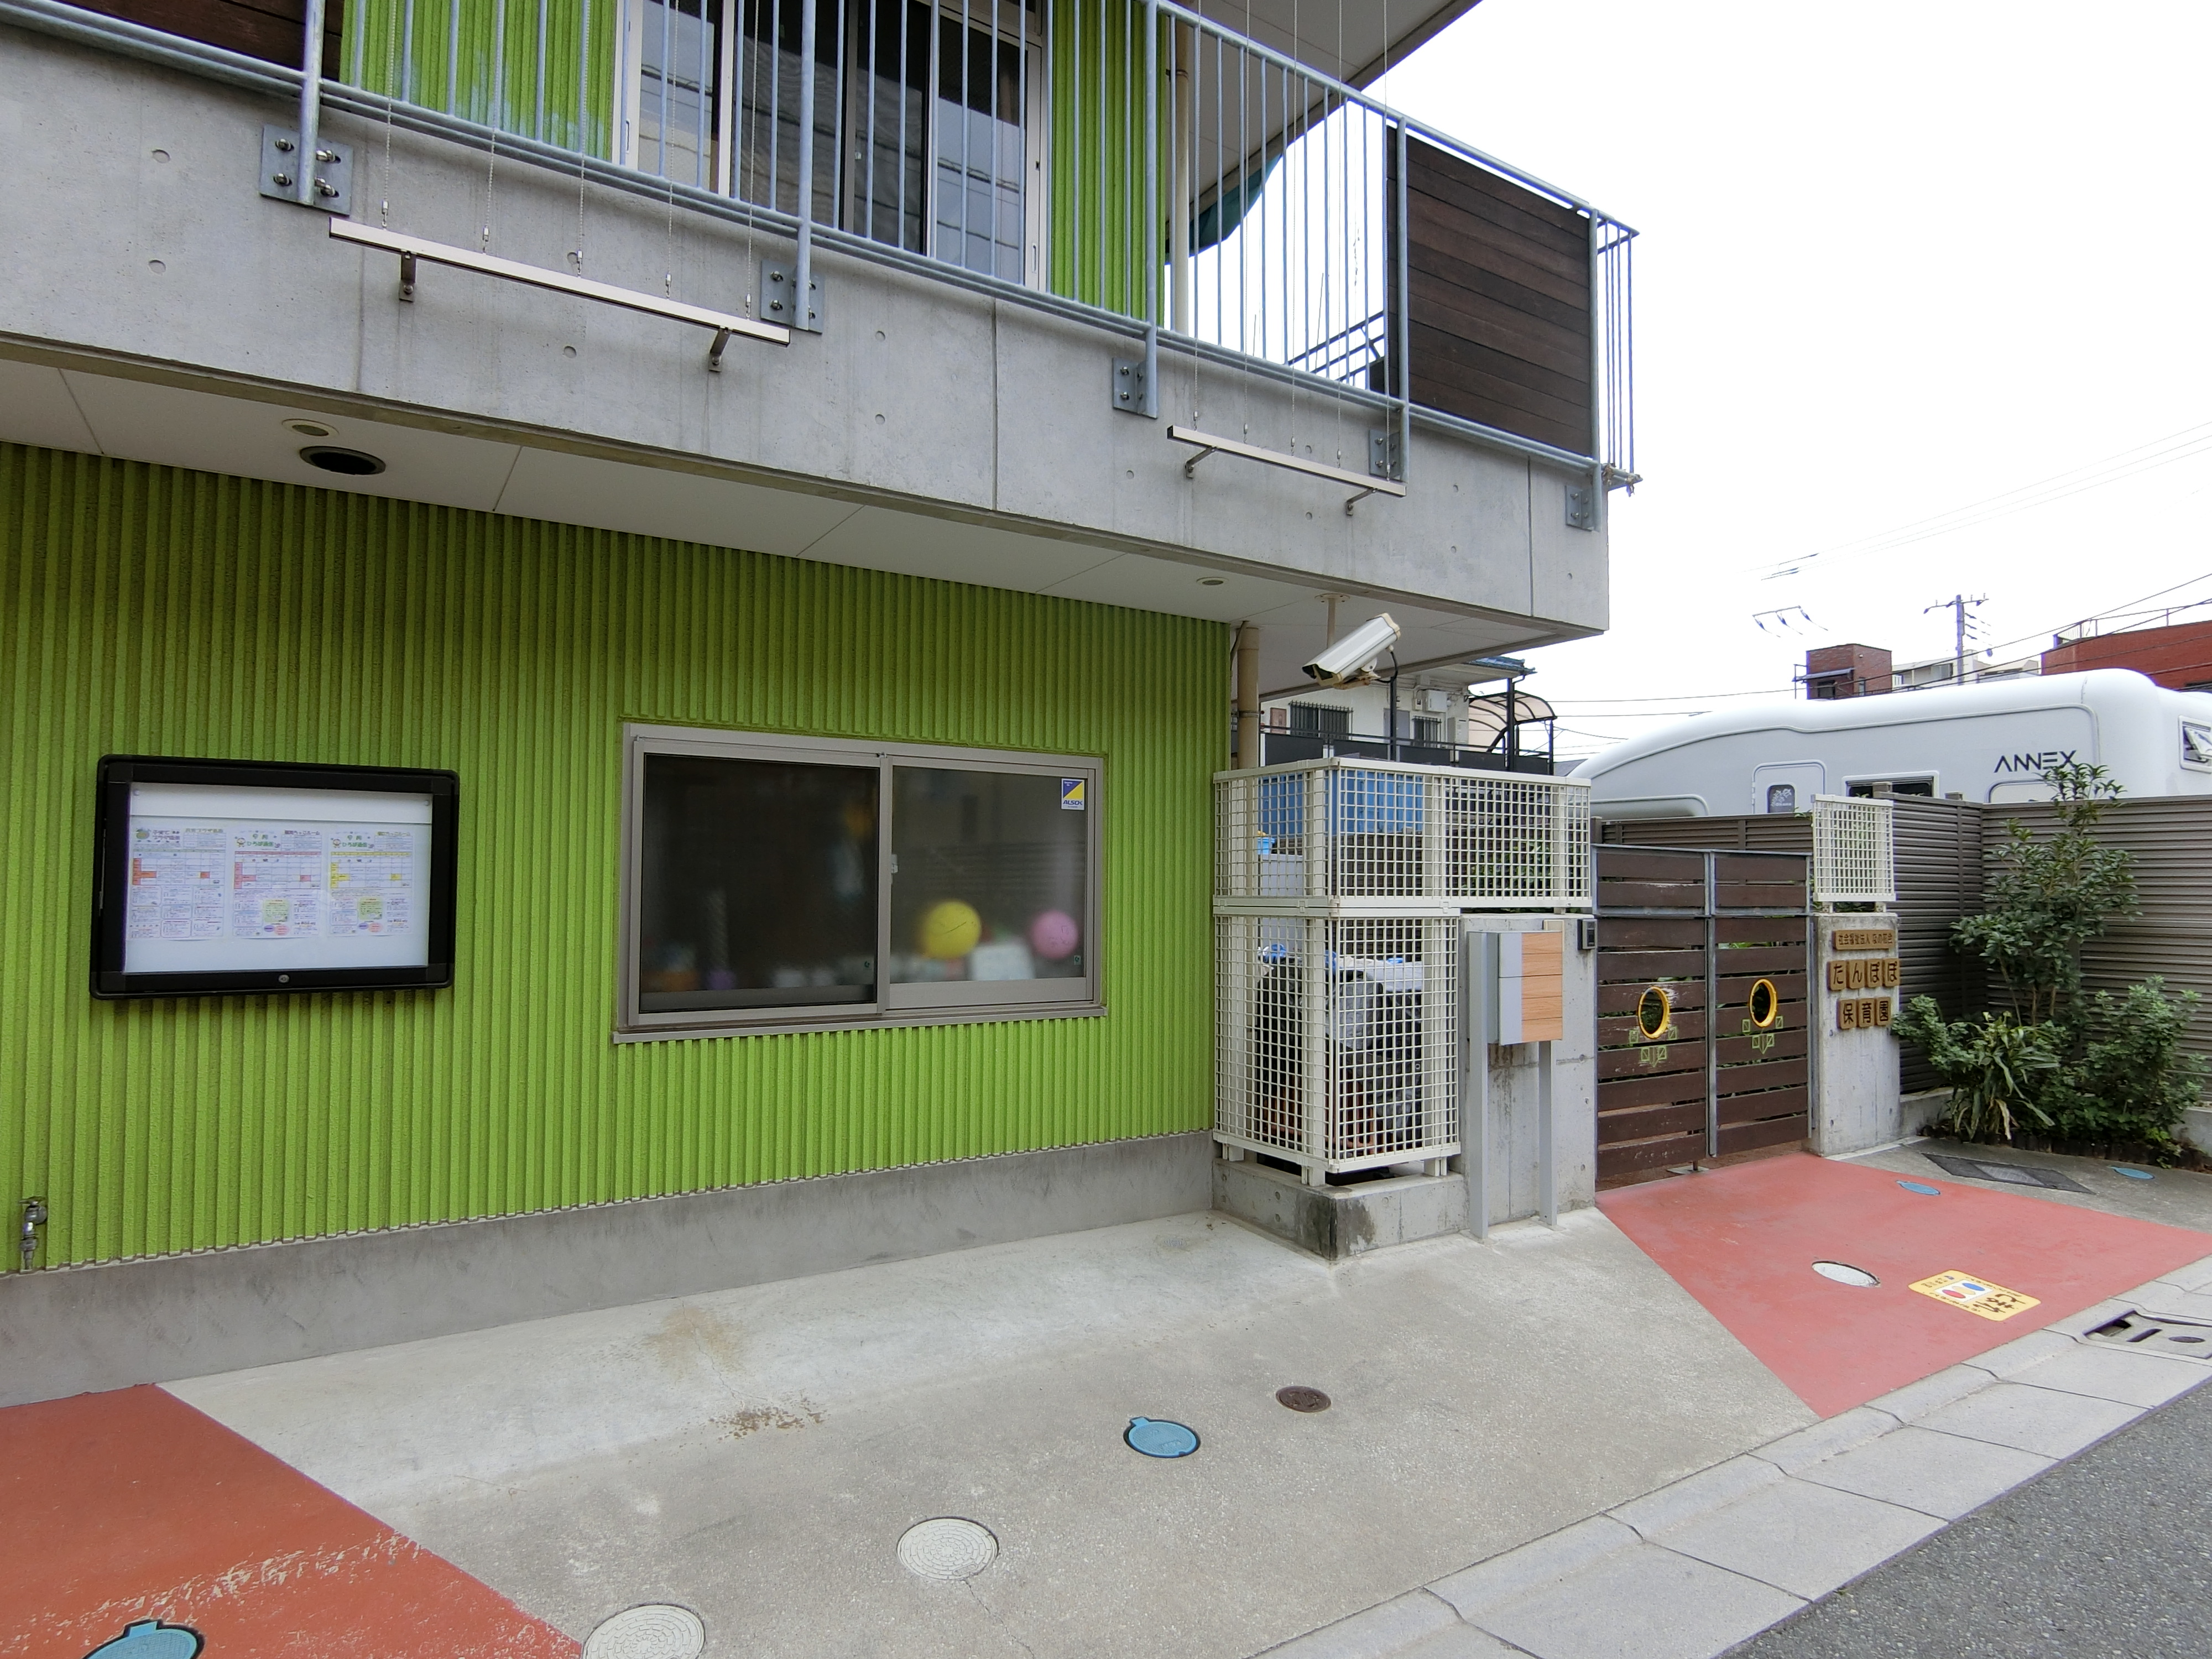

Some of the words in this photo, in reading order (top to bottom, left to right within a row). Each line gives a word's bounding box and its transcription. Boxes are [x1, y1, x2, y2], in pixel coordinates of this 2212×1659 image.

[1994, 750, 2077, 773] ANNEX
[1838, 933, 1870, 945] 社会福祉法人
[1833, 961, 1898, 985] たんぽぽ
[1843, 1000, 1888, 1025] 保育園
